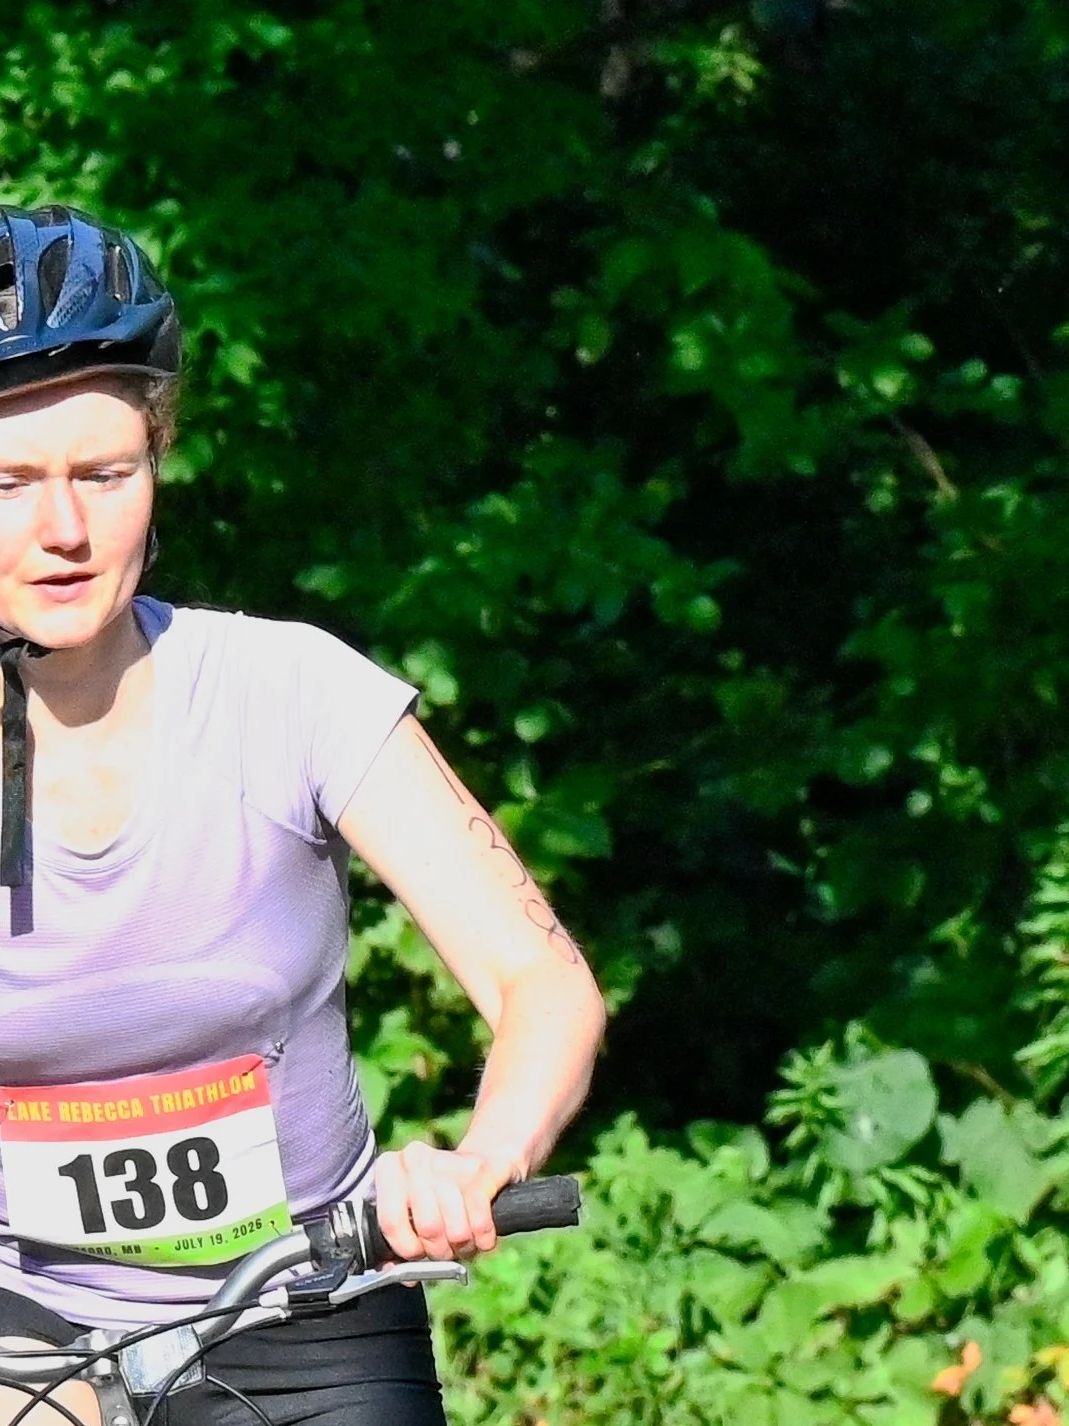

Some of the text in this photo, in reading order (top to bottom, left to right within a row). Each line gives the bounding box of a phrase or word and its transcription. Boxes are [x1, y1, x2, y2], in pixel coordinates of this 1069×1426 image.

[7, 1072, 256, 1123] LAKE REBECCA TRIATHLON
[58, 1136, 229, 1234] 138
[121, 1244, 142, 1255] MN
[174, 1237, 204, 1252] JULY
[232, 1218, 263, 1240] 2026
